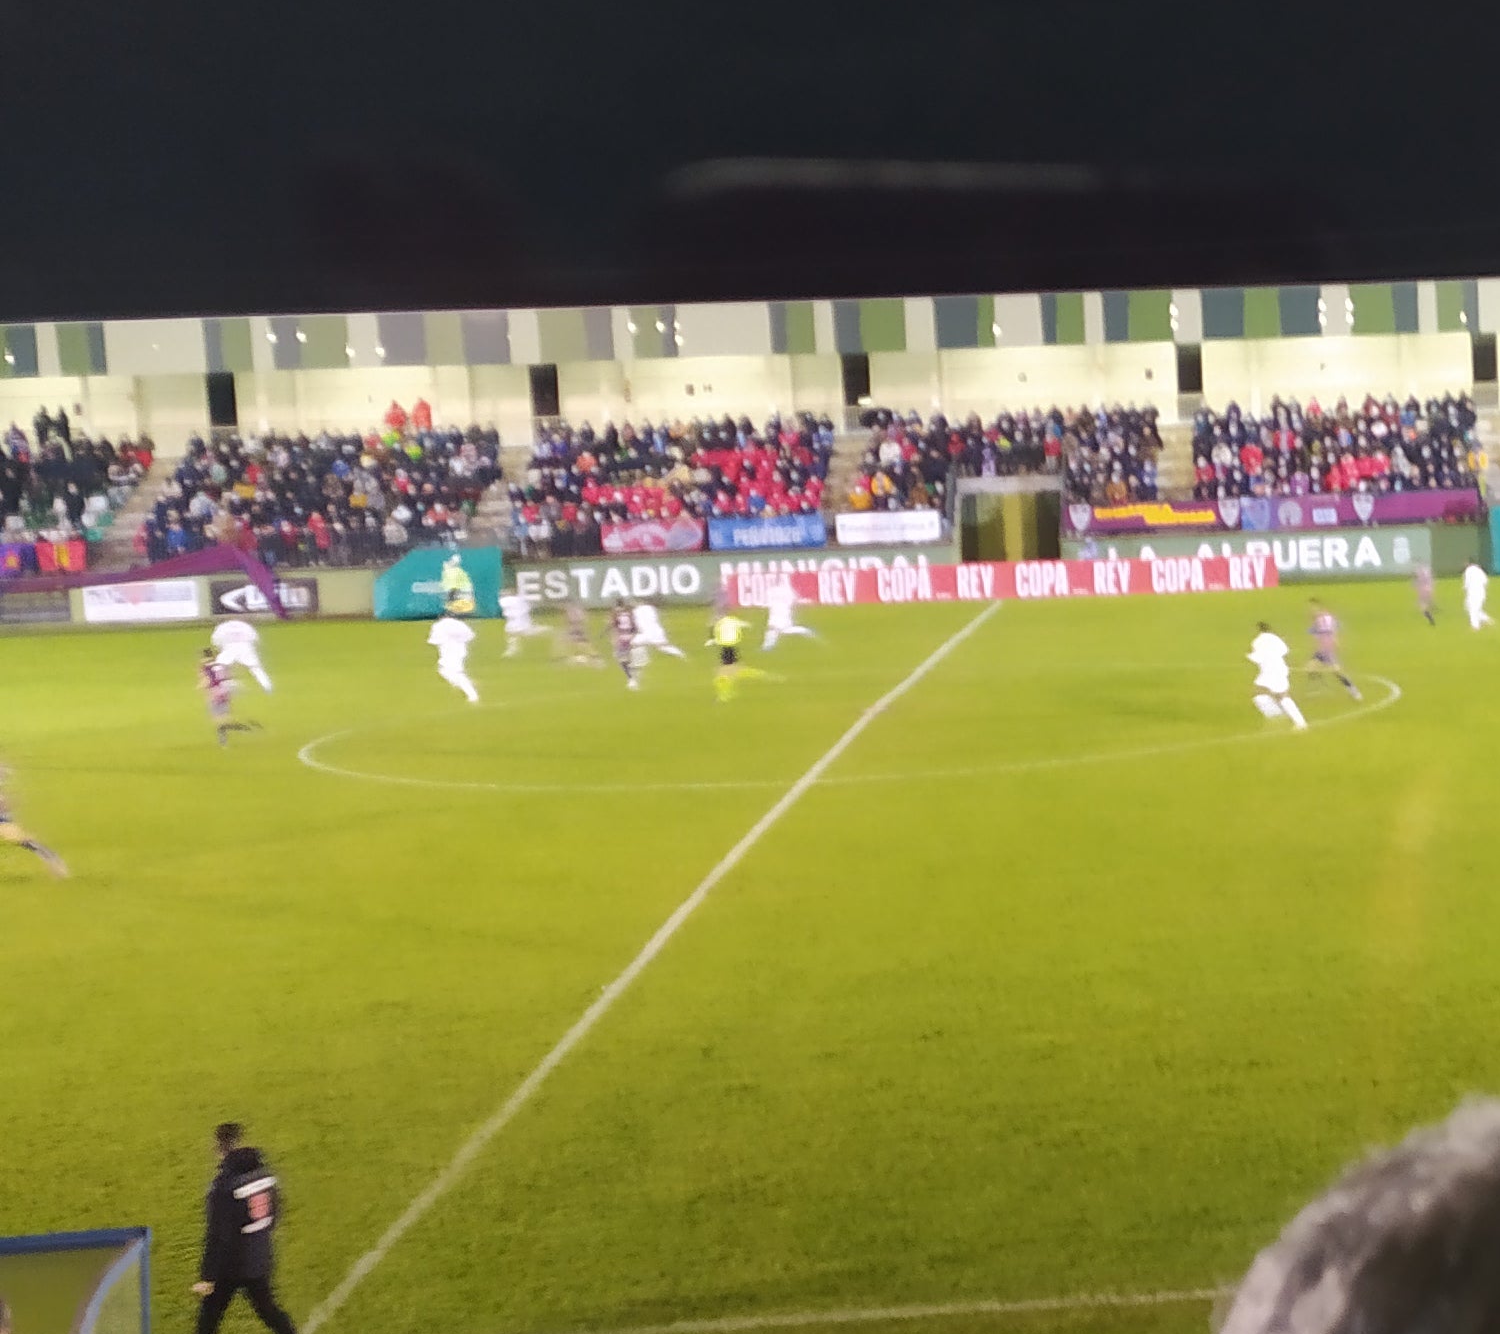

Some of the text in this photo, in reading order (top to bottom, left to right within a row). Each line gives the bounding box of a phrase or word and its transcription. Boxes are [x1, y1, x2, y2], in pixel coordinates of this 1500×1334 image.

[516, 563, 700, 600] ESTADIO
[818, 569, 857, 603] REY
[877, 564, 933, 601] COPA
[956, 563, 994, 598] REY
[1015, 561, 1069, 597] COPA
[1093, 559, 1130, 594] REY
[1151, 557, 1205, 592] COPA
[1229, 554, 1266, 588] REY
